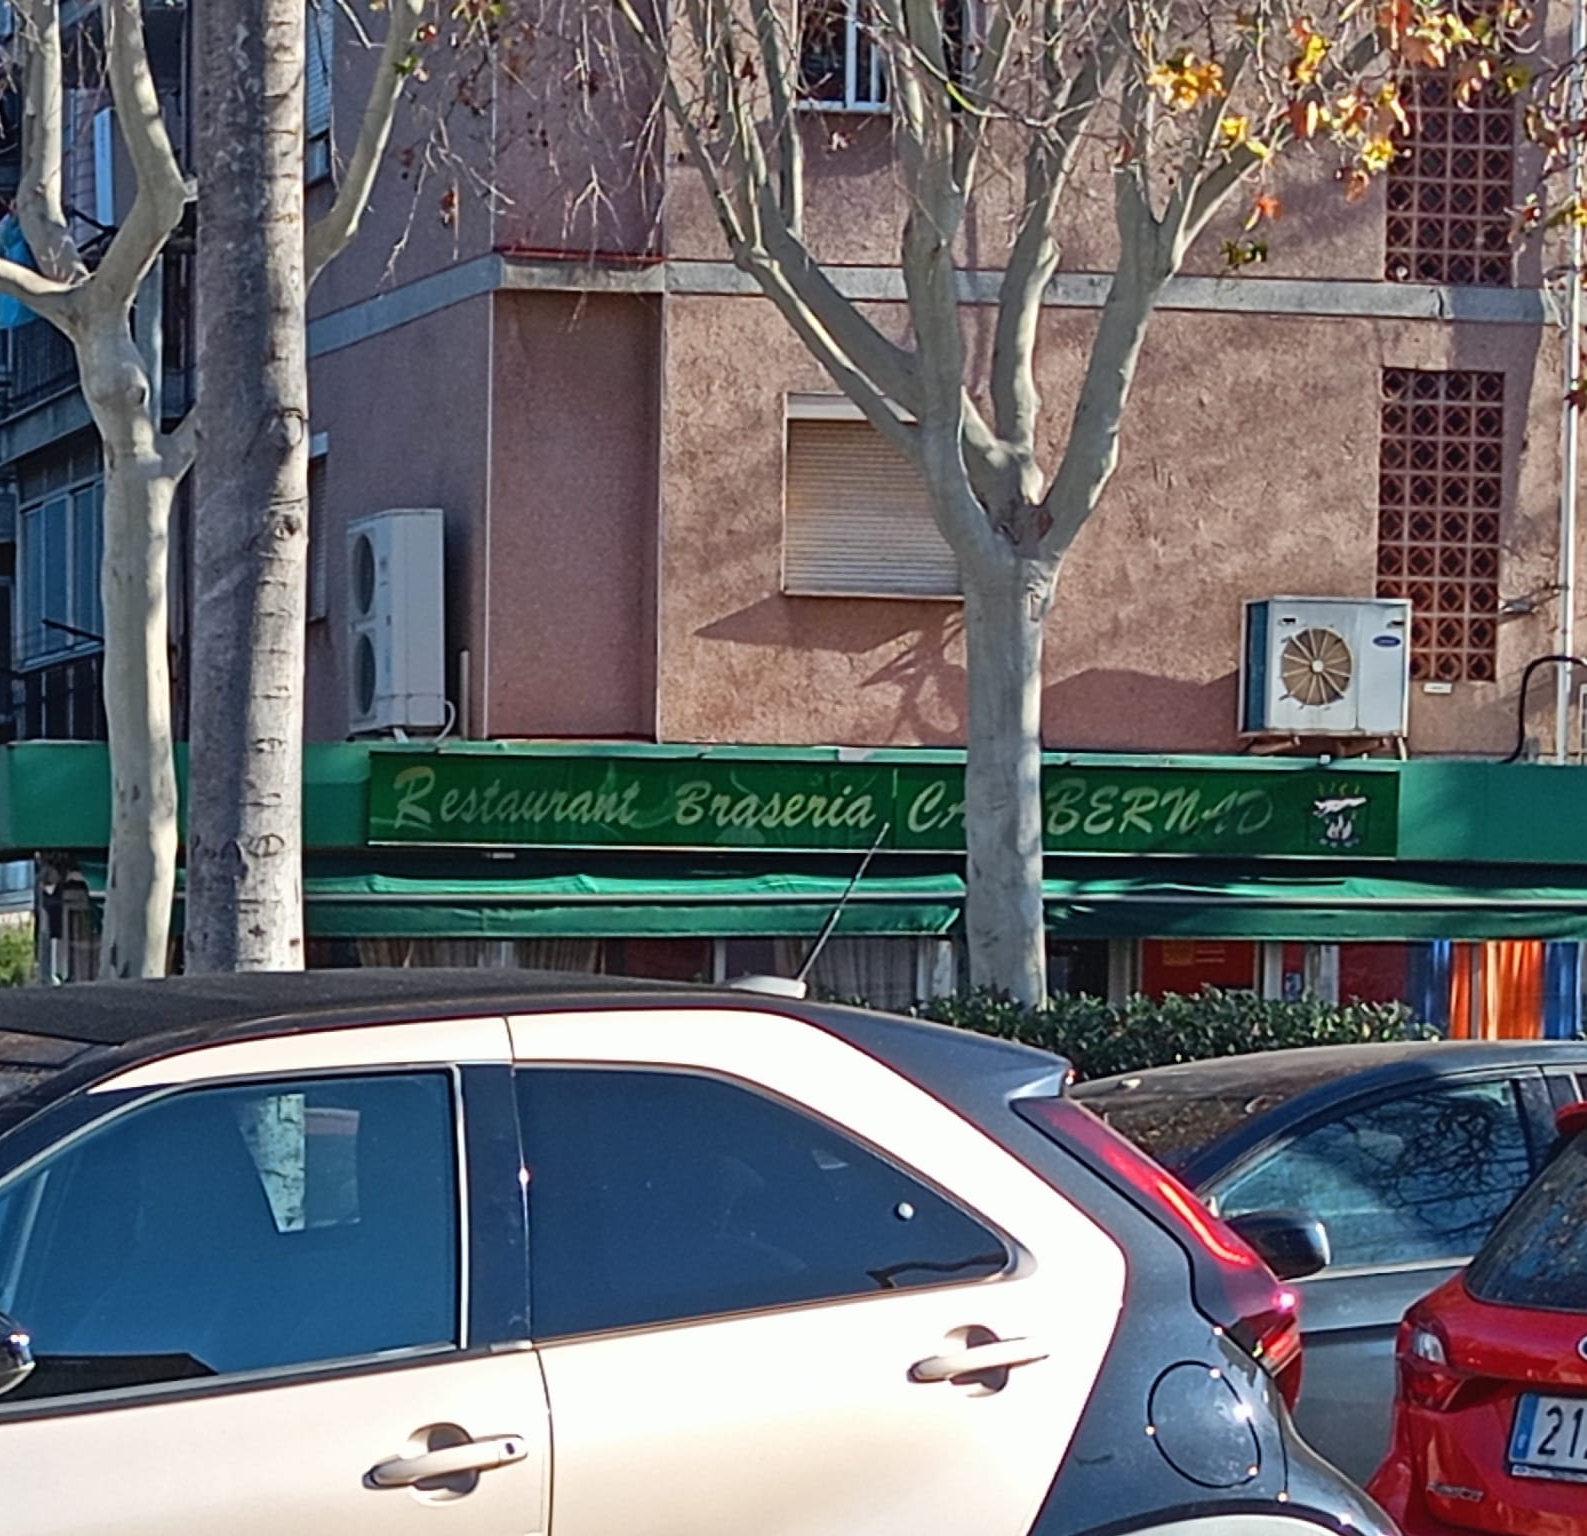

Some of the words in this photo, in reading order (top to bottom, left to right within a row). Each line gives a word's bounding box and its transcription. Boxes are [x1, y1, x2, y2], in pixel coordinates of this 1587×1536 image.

[393, 765, 640, 830] Restaurant
[674, 780, 877, 829] Braseria
[1537, 1405, 1587, 1460] 21
